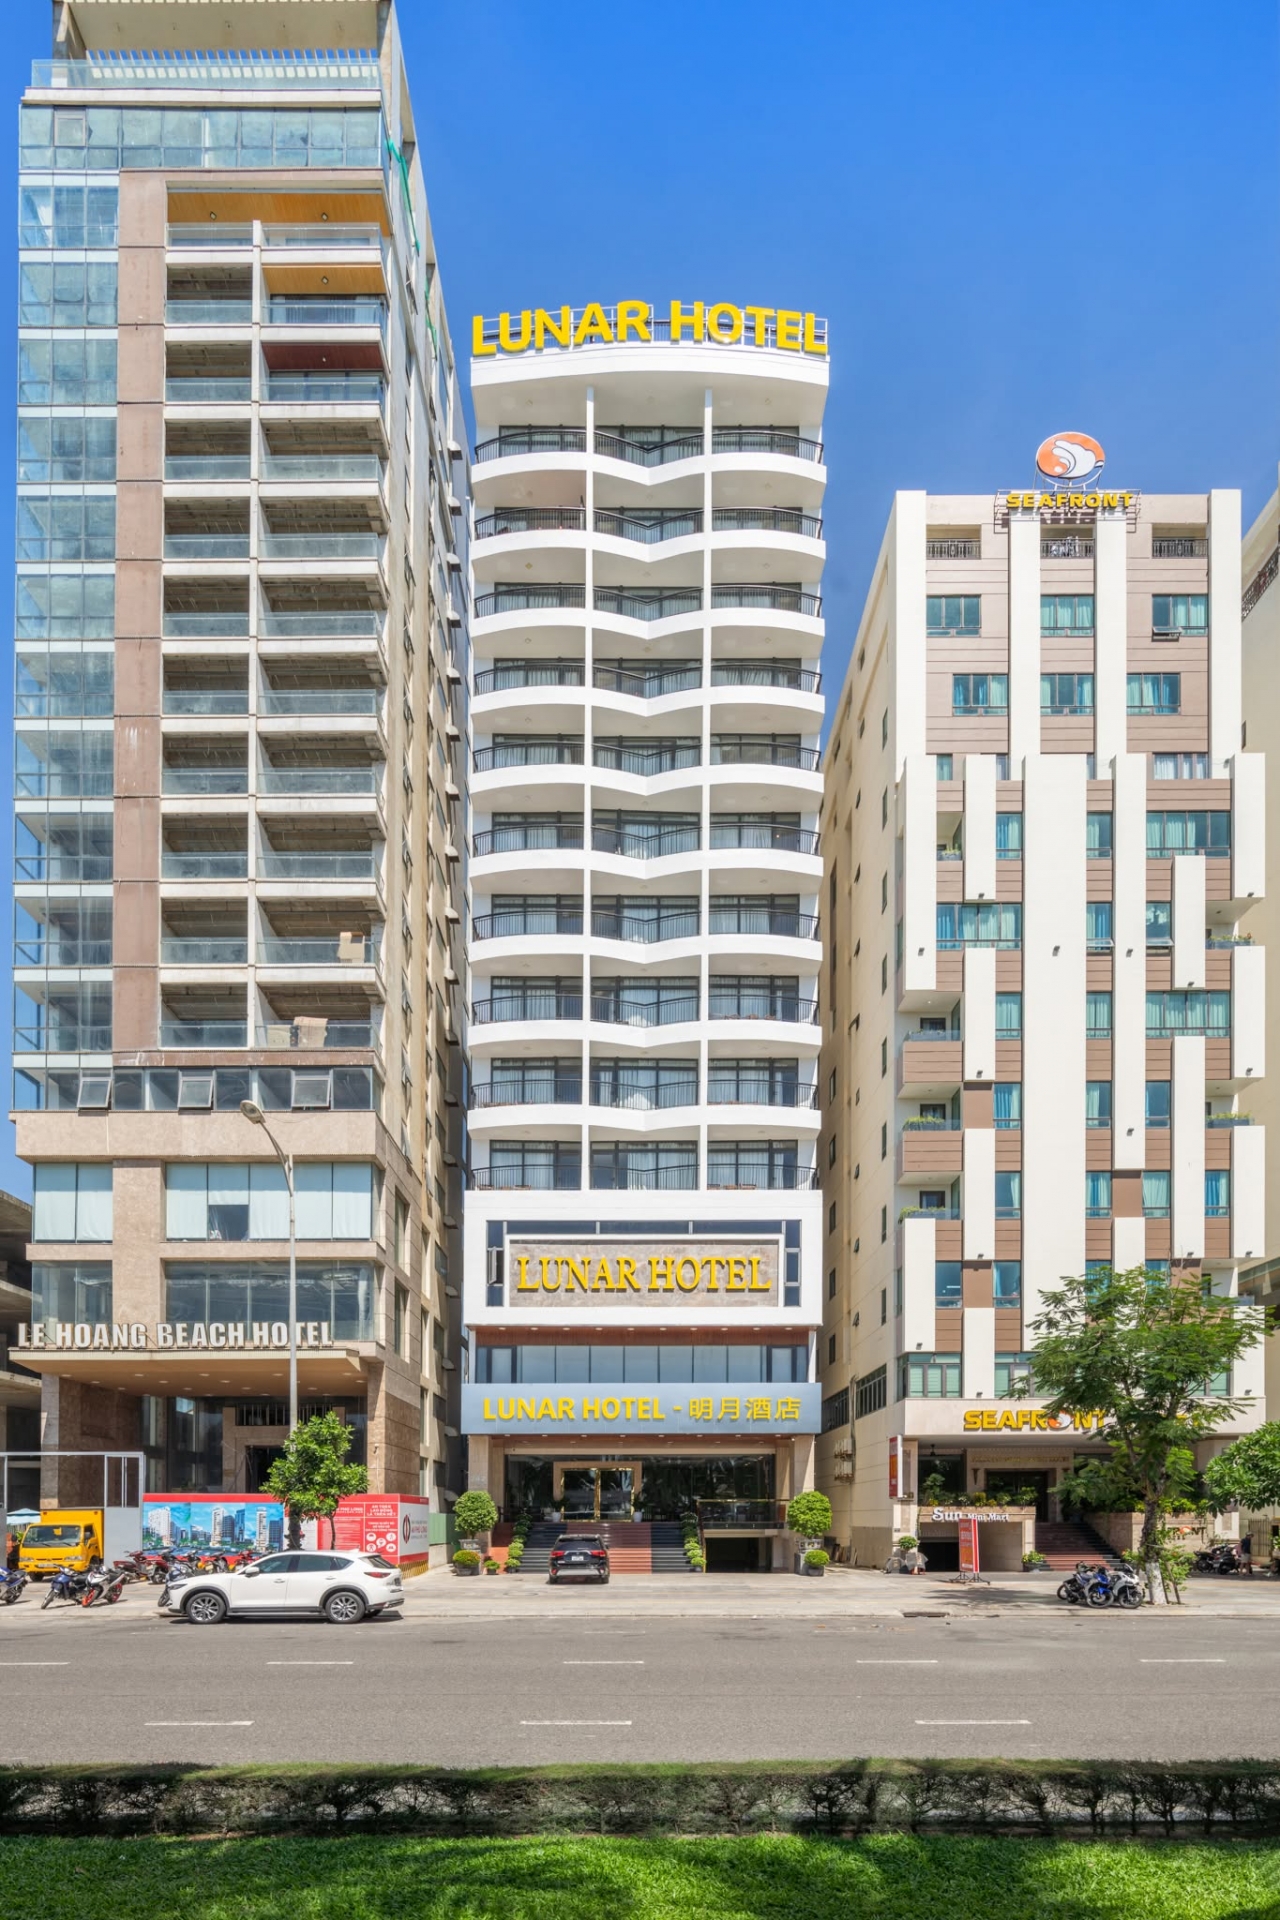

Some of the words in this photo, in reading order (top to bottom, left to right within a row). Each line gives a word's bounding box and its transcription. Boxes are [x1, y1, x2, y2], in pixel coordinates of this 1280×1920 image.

[472, 300, 652, 357] LUNAR
[670, 300, 829, 356] HOTEL
[1006, 493, 1134, 509] SEAFRONT
[516, 1256, 641, 1291] LUNAR
[647, 1256, 773, 1291] HOTEL
[17, 1322, 46, 1347] LE
[55, 1321, 147, 1348] HOANG
[156, 1322, 245, 1348] BEACH
[251, 1321, 334, 1348] HOTEL
[483, 1397, 576, 1421] LUNAR
[582, 1397, 666, 1421] HOTEL
[688, 1396, 801, 1421] 明月酒店
[932, 1507, 962, 1521] Sun
